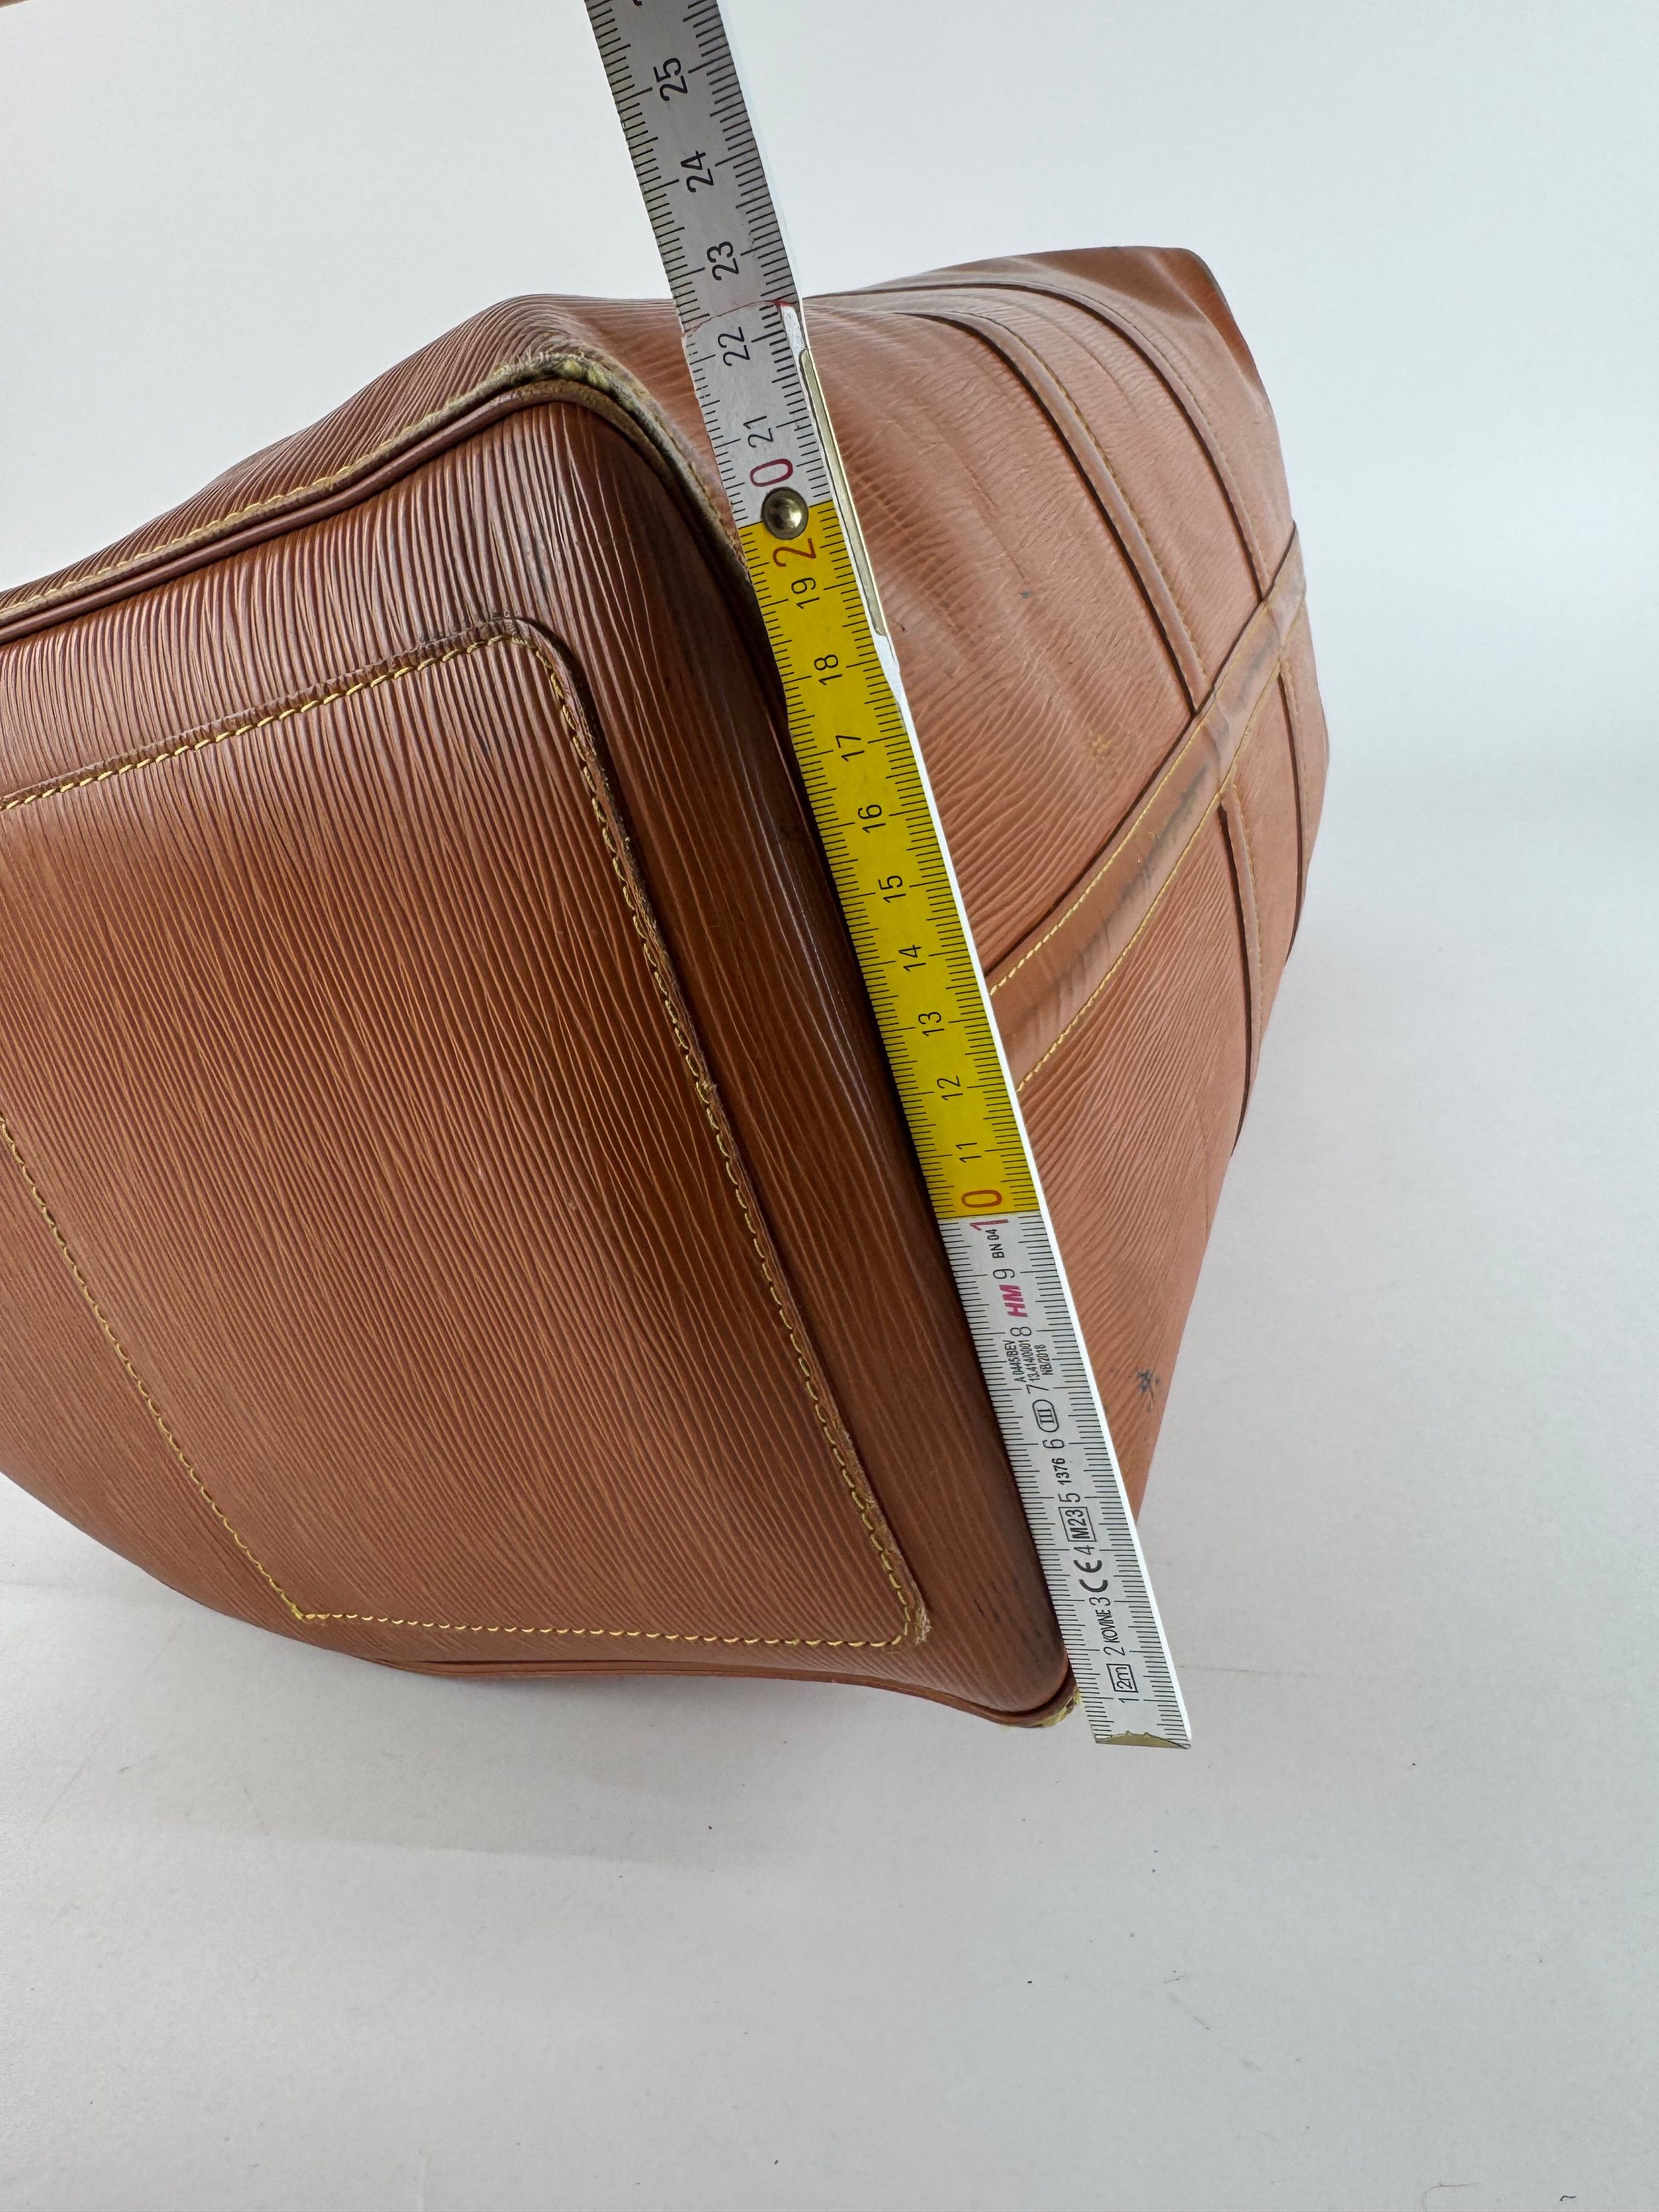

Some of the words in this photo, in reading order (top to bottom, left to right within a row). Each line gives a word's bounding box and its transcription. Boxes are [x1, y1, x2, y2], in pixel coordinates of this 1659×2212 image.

[653, 58, 688, 101] 25
[681, 150, 714, 192] 24
[707, 241, 739, 281] 23
[717, 326, 750, 367] 22
[743, 415, 774, 448] 21
[791, 578, 820, 609] 19
[814, 653, 842, 685] 18
[836, 735, 865, 762] 17
[858, 804, 886, 833] 16
[878, 875, 906, 903] 15
[899, 944, 926, 971] 14
[918, 1011, 945, 1036] 13
[937, 1076, 963, 1100] 12
[956, 1142, 981, 1163] 11
[985, 1229, 1000, 1241] 04
[989, 1243, 1005, 1259] BN
[993, 1268, 1015, 1279] 9
[999, 1284, 1028, 1318] HM
[1010, 1326, 1032, 1337] 8
[1026, 1384, 1049, 1394] 7
[1043, 1438, 1065, 1449] 6
[1052, 1457, 1072, 1485] 1376
[1058, 1493, 1081, 1503] 5
[1065, 1509, 1091, 1540] M23
[1074, 1545, 1095, 1555] 4
[1089, 1596, 1110, 1607] 3
[1103, 1646, 1126, 1656] 2
[1115, 1667, 1133, 1689] 2m
